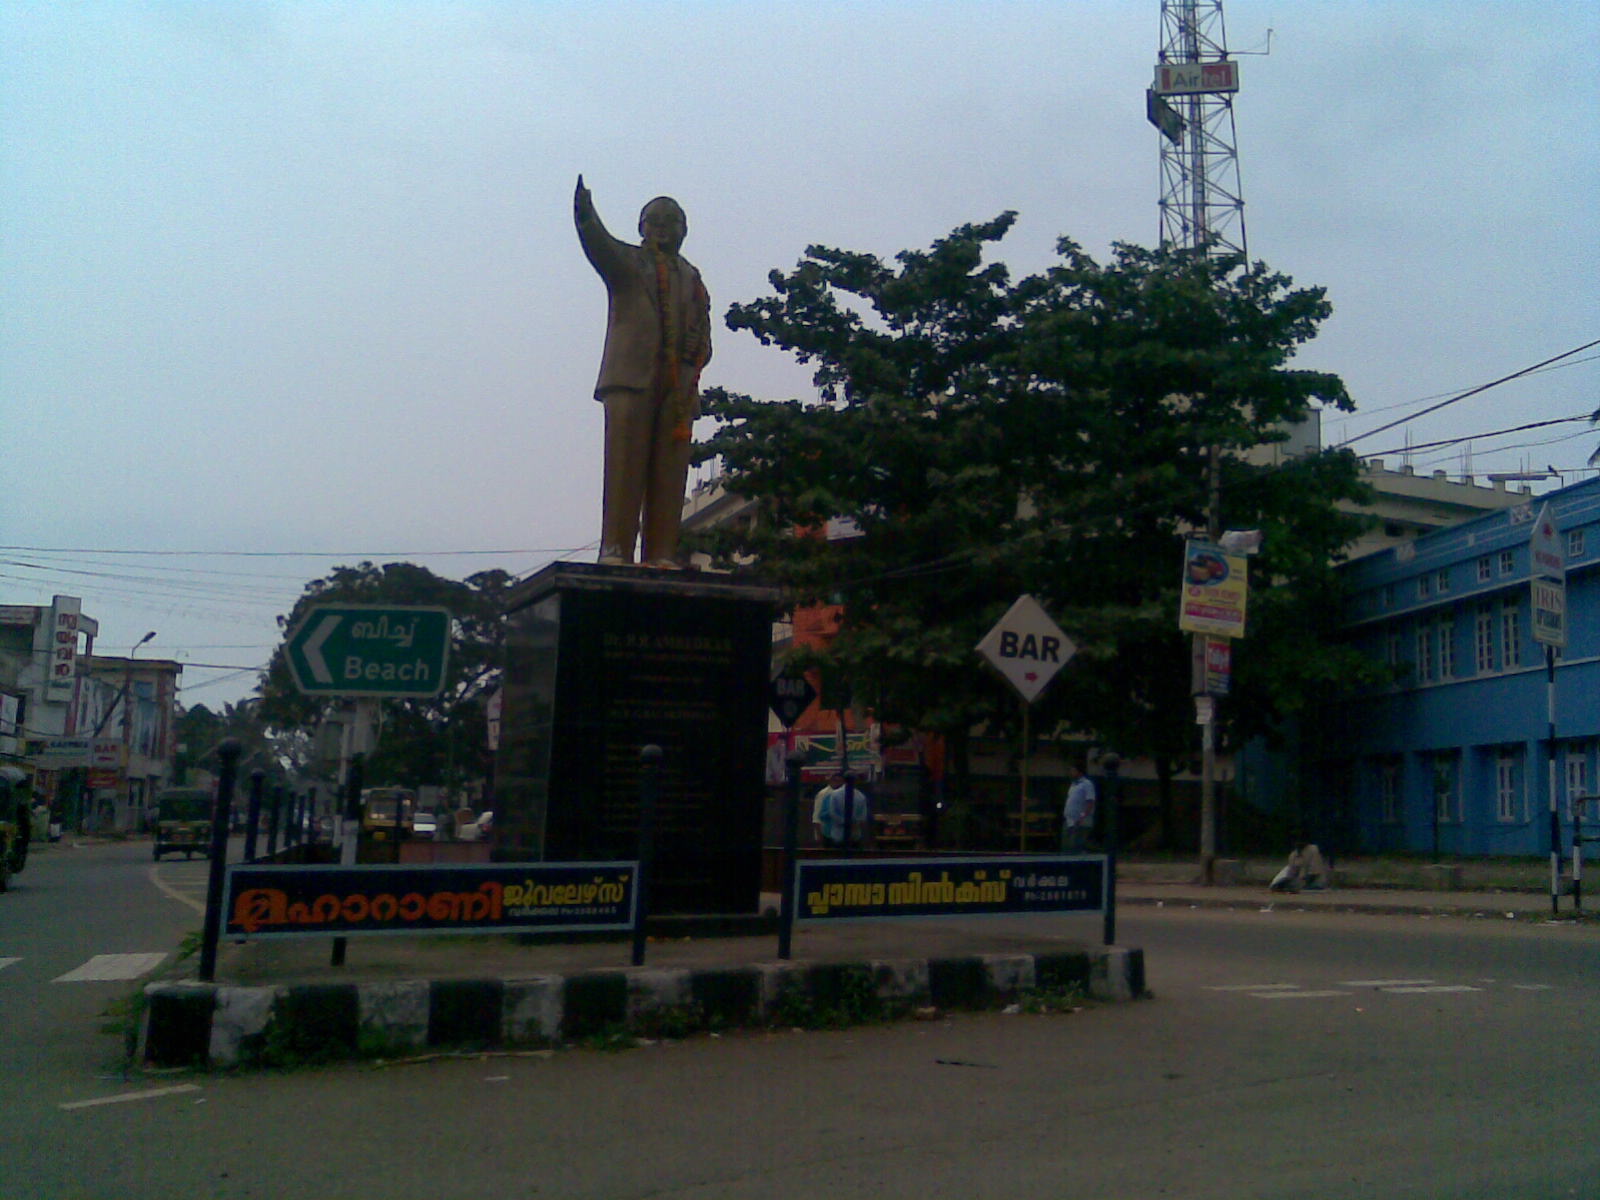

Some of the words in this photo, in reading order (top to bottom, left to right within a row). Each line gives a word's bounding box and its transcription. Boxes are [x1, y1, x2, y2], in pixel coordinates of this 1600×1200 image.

[999, 631, 1060, 663] BAR
[344, 656, 430, 681] Beach
[229, 881, 505, 933] മഹാറാണി
